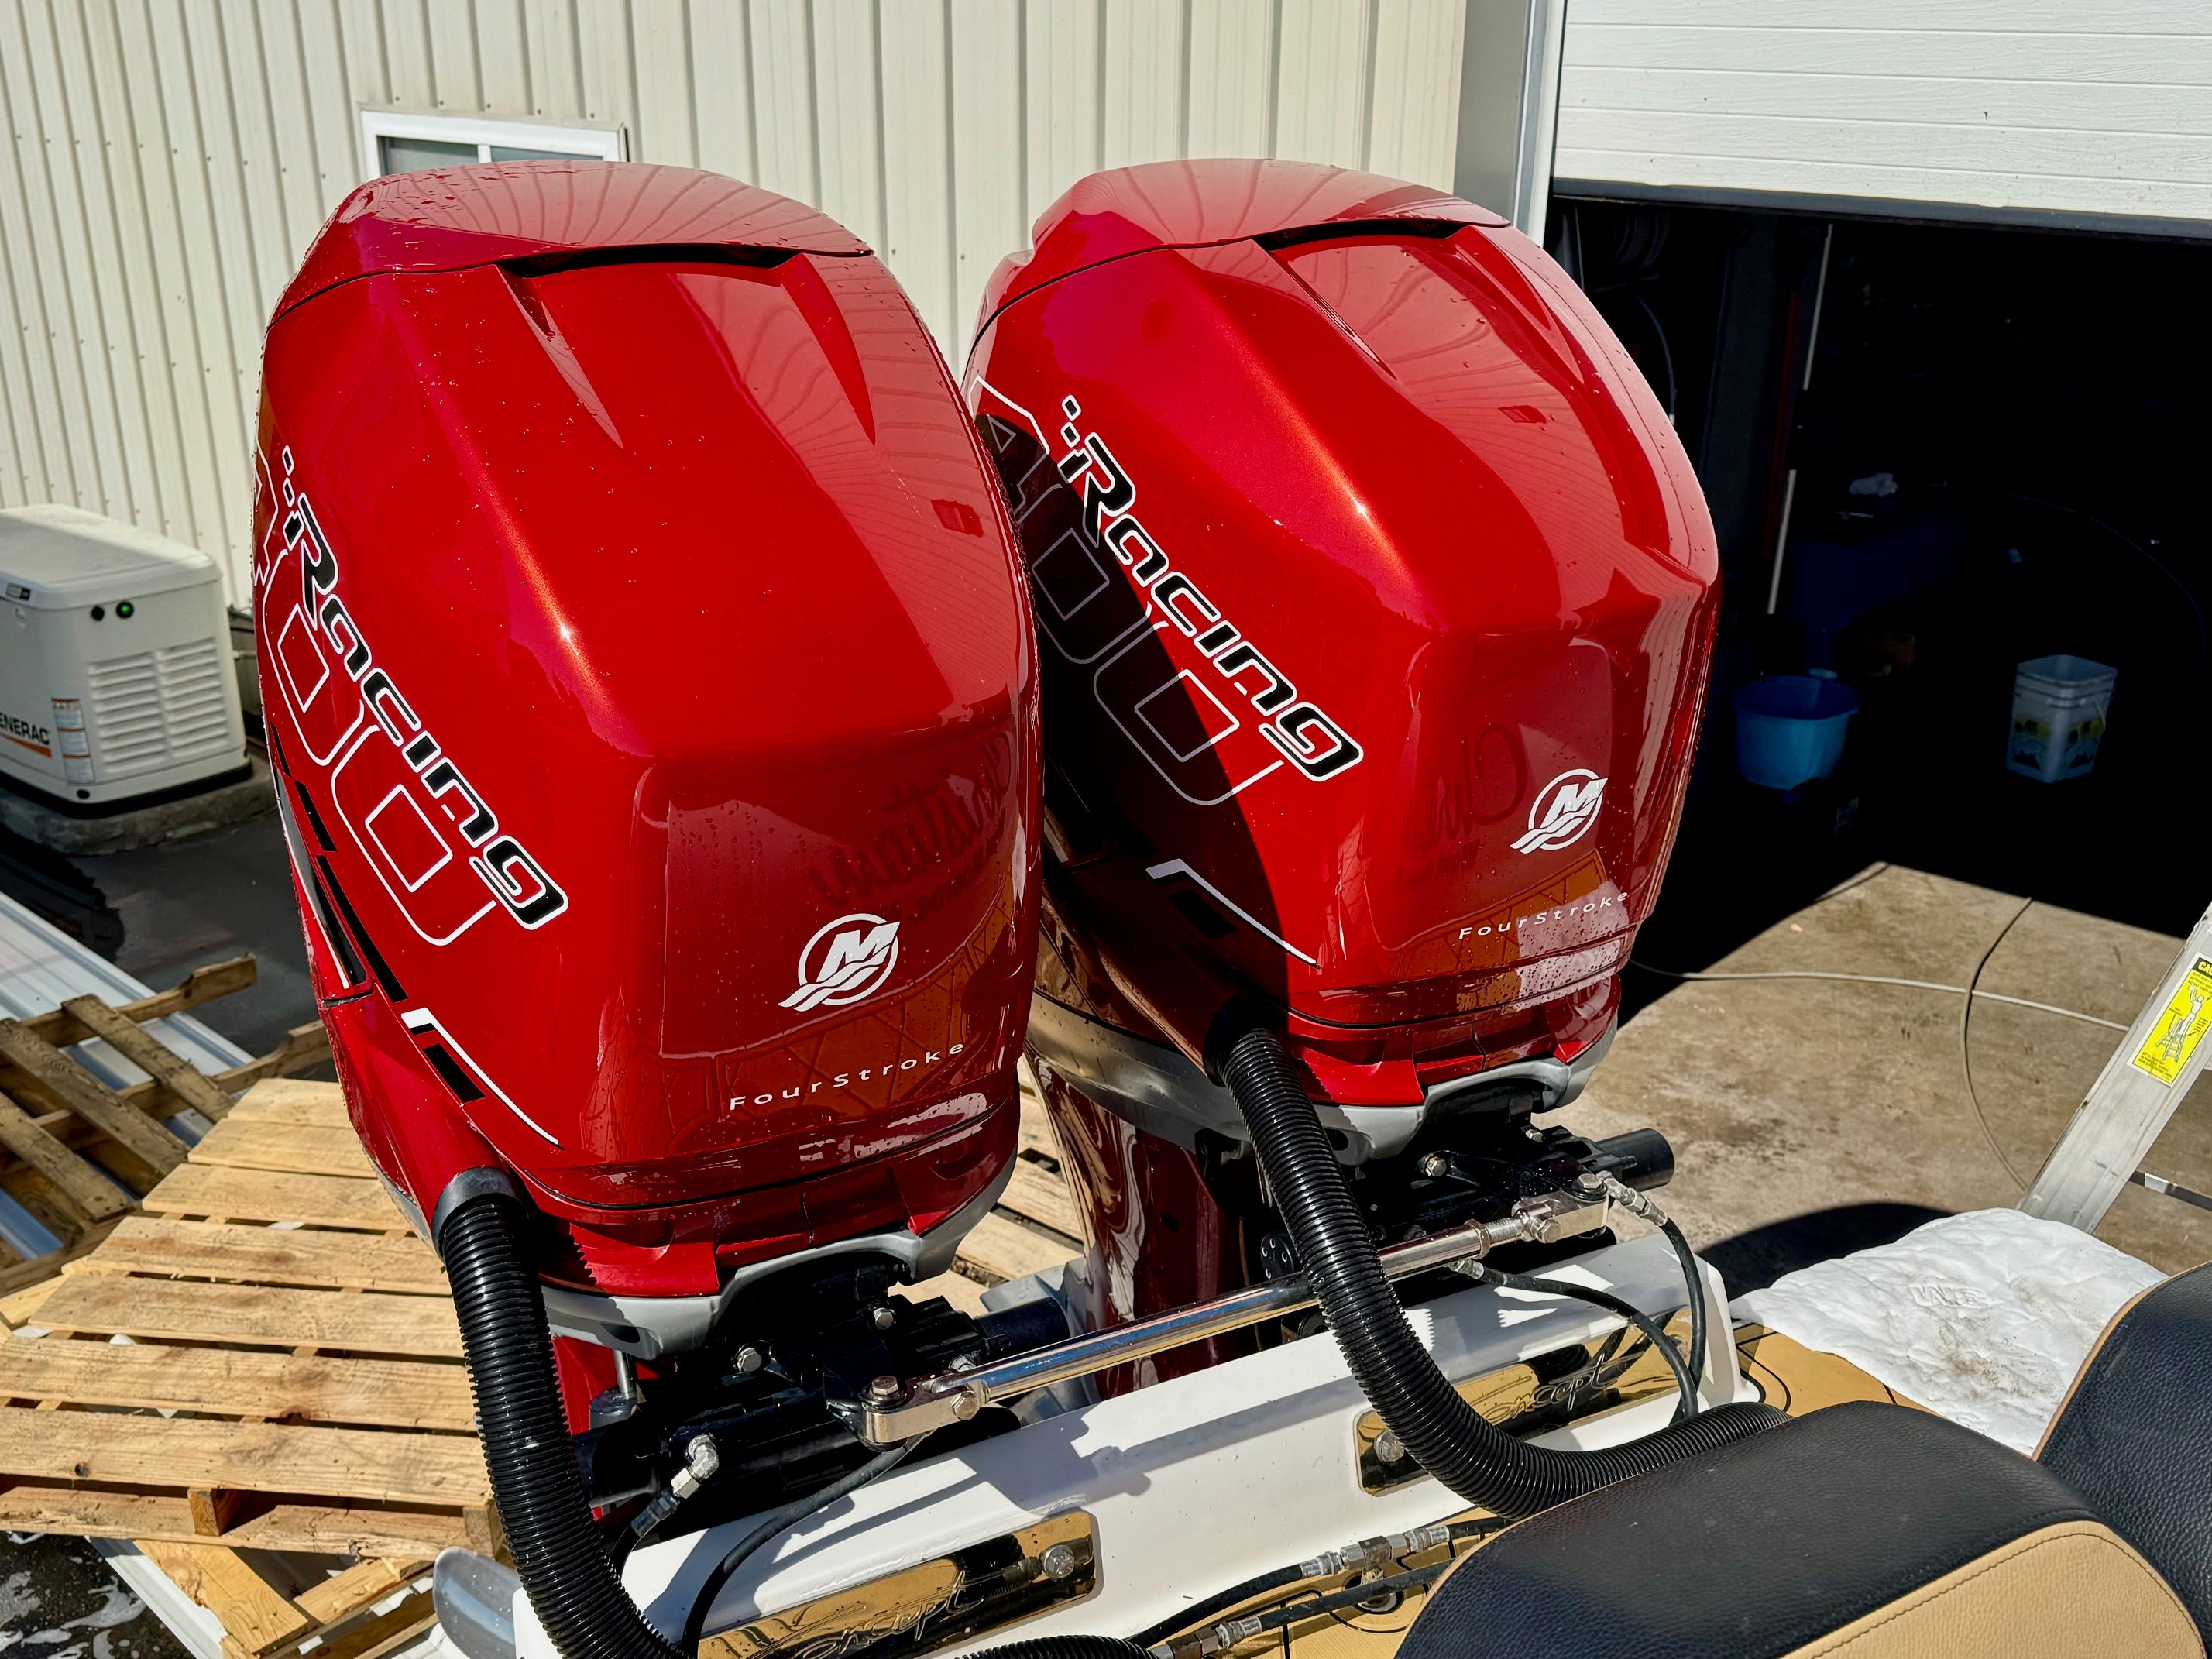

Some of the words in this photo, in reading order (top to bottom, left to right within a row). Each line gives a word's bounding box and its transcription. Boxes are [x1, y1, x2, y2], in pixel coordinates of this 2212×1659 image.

[1057, 432, 1363, 781] Racing
[283, 493, 568, 930] Racing
[1458, 891, 1628, 940] FourStroke
[729, 1042, 963, 1111] FourStroke
